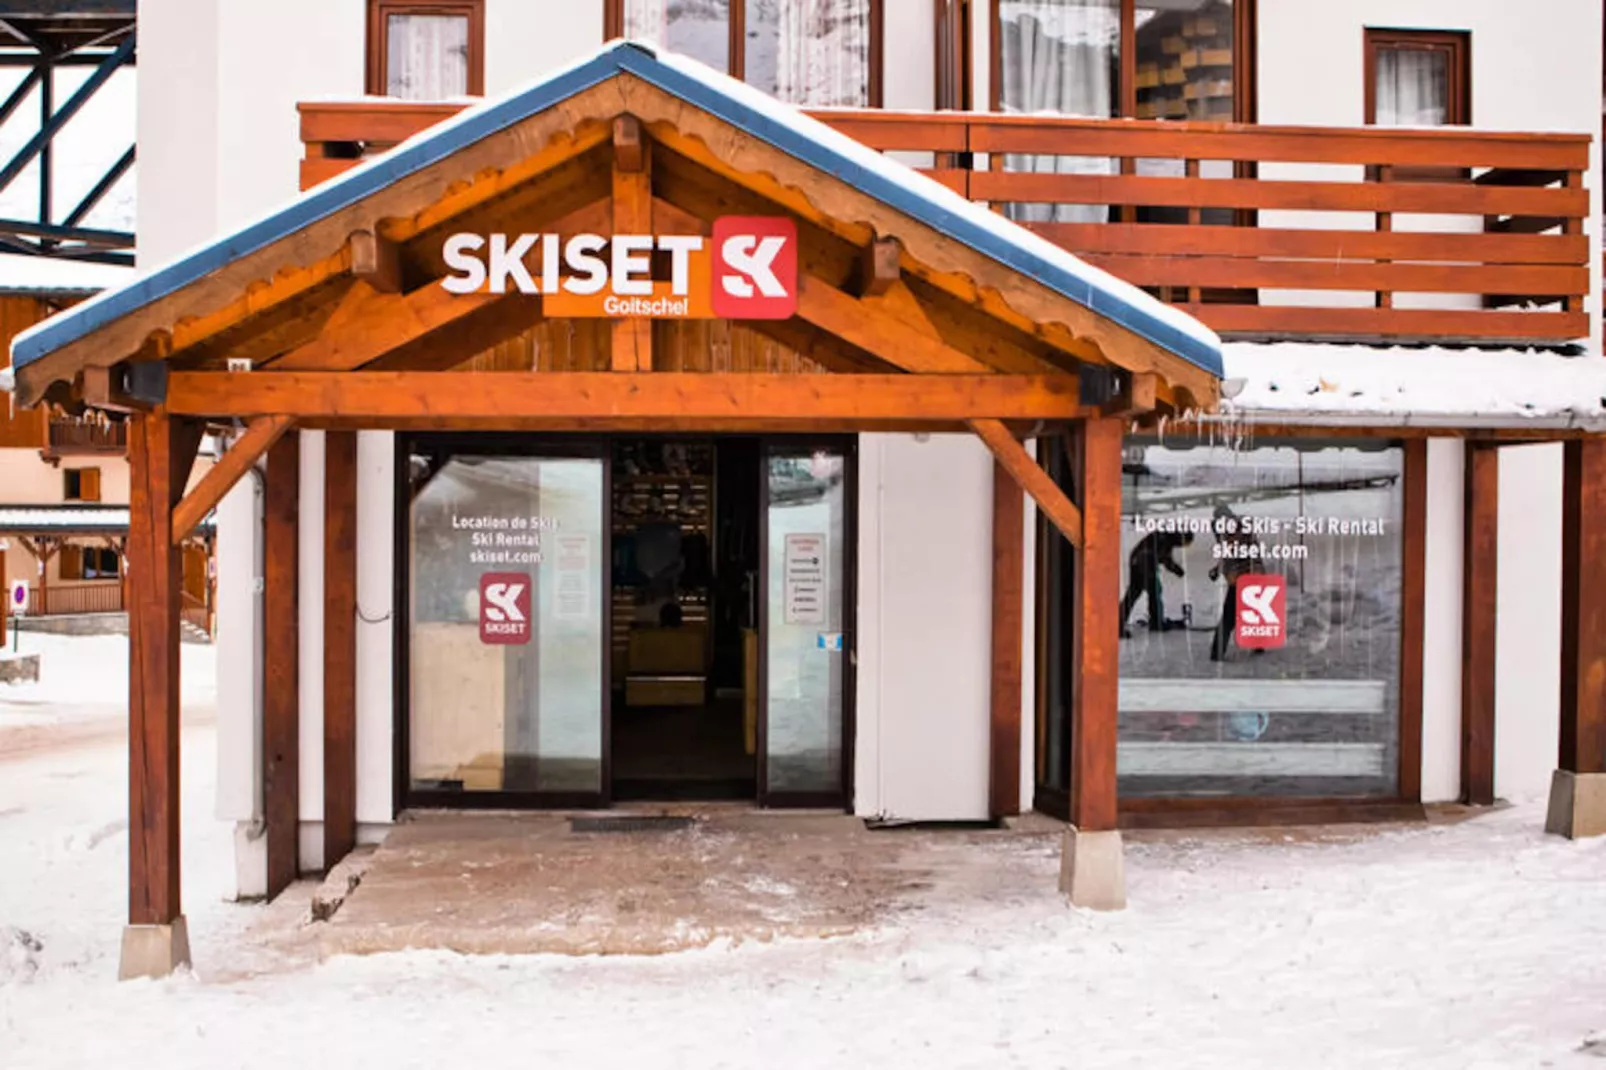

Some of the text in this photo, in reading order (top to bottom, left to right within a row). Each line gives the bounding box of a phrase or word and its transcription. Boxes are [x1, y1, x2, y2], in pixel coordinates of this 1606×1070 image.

[440, 232, 703, 296] SKISET
[603, 296, 688, 316] Goitschel
[452, 515, 508, 530] Location
[511, 516, 527, 530] de
[1135, 515, 1210, 533] Location
[1215, 516, 1236, 534] de
[1241, 517, 1279, 534] Skis
[1295, 518, 1323, 535] Ski
[1328, 518, 1385, 536] Rental
[472, 532, 539, 547] Ski Rental
[469, 550, 541, 564] skiset.com
[1212, 541, 1308, 560] skiset.com
[485, 623, 525, 634] SKISET
[1241, 626, 1280, 637] SKISET
